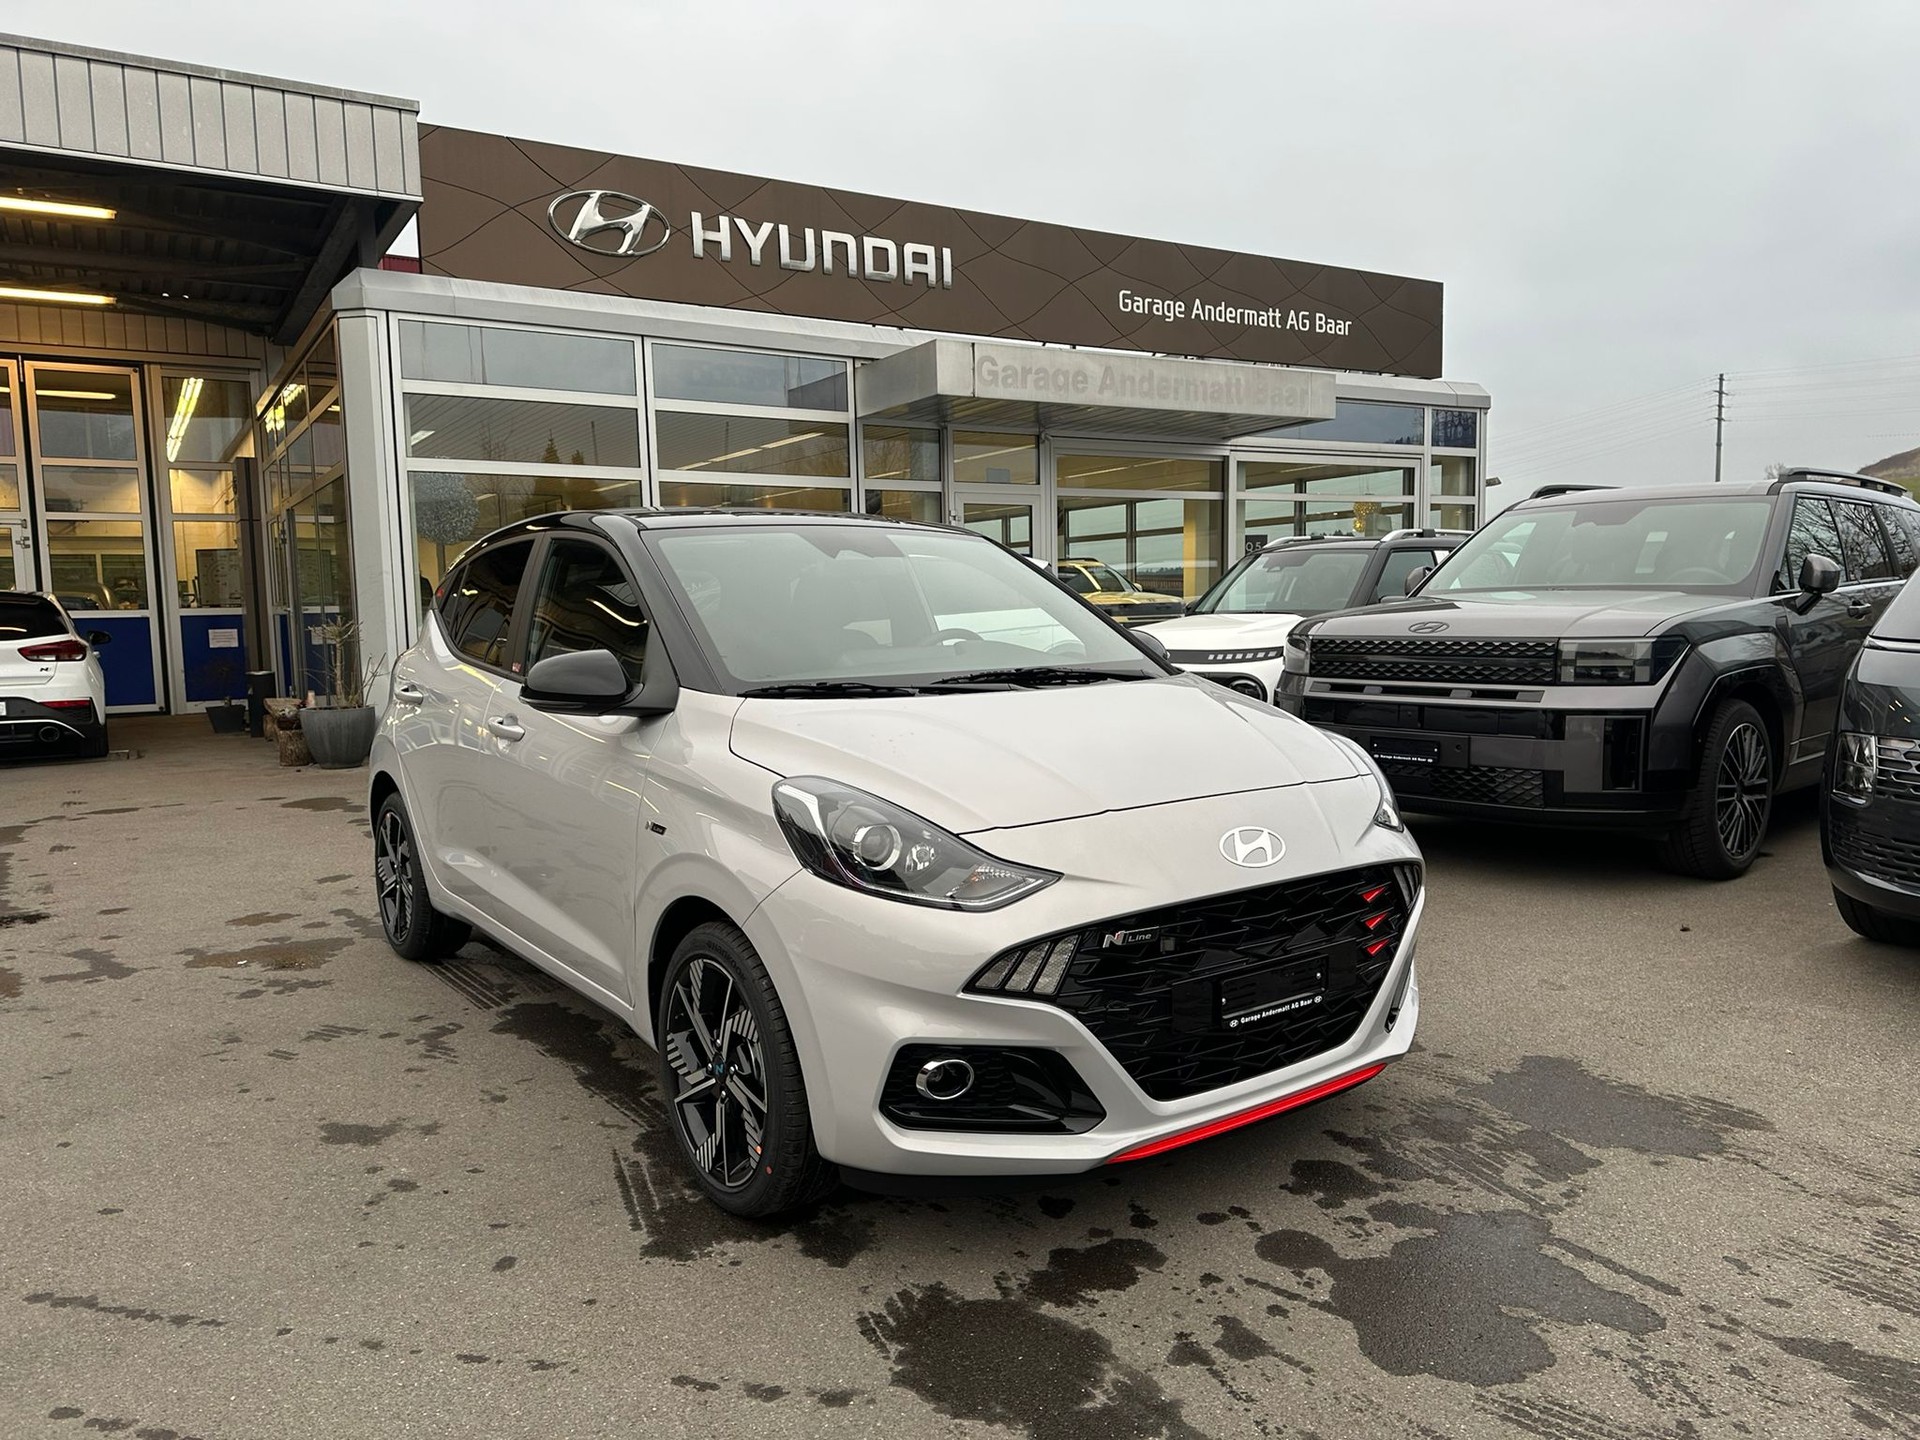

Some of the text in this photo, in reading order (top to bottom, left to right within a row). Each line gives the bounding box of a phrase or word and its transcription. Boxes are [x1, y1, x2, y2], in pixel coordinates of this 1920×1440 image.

[691, 211, 953, 289] HYUNDAI
[1119, 290, 1352, 336] Garage Andermatt AG Baar
[976, 355, 1089, 397] Garage
[1099, 365, 1242, 402] Andermatt
[1102, 930, 1152, 948] N Line
[1240, 999, 1313, 1024] Garage Andermatt AG Baar
